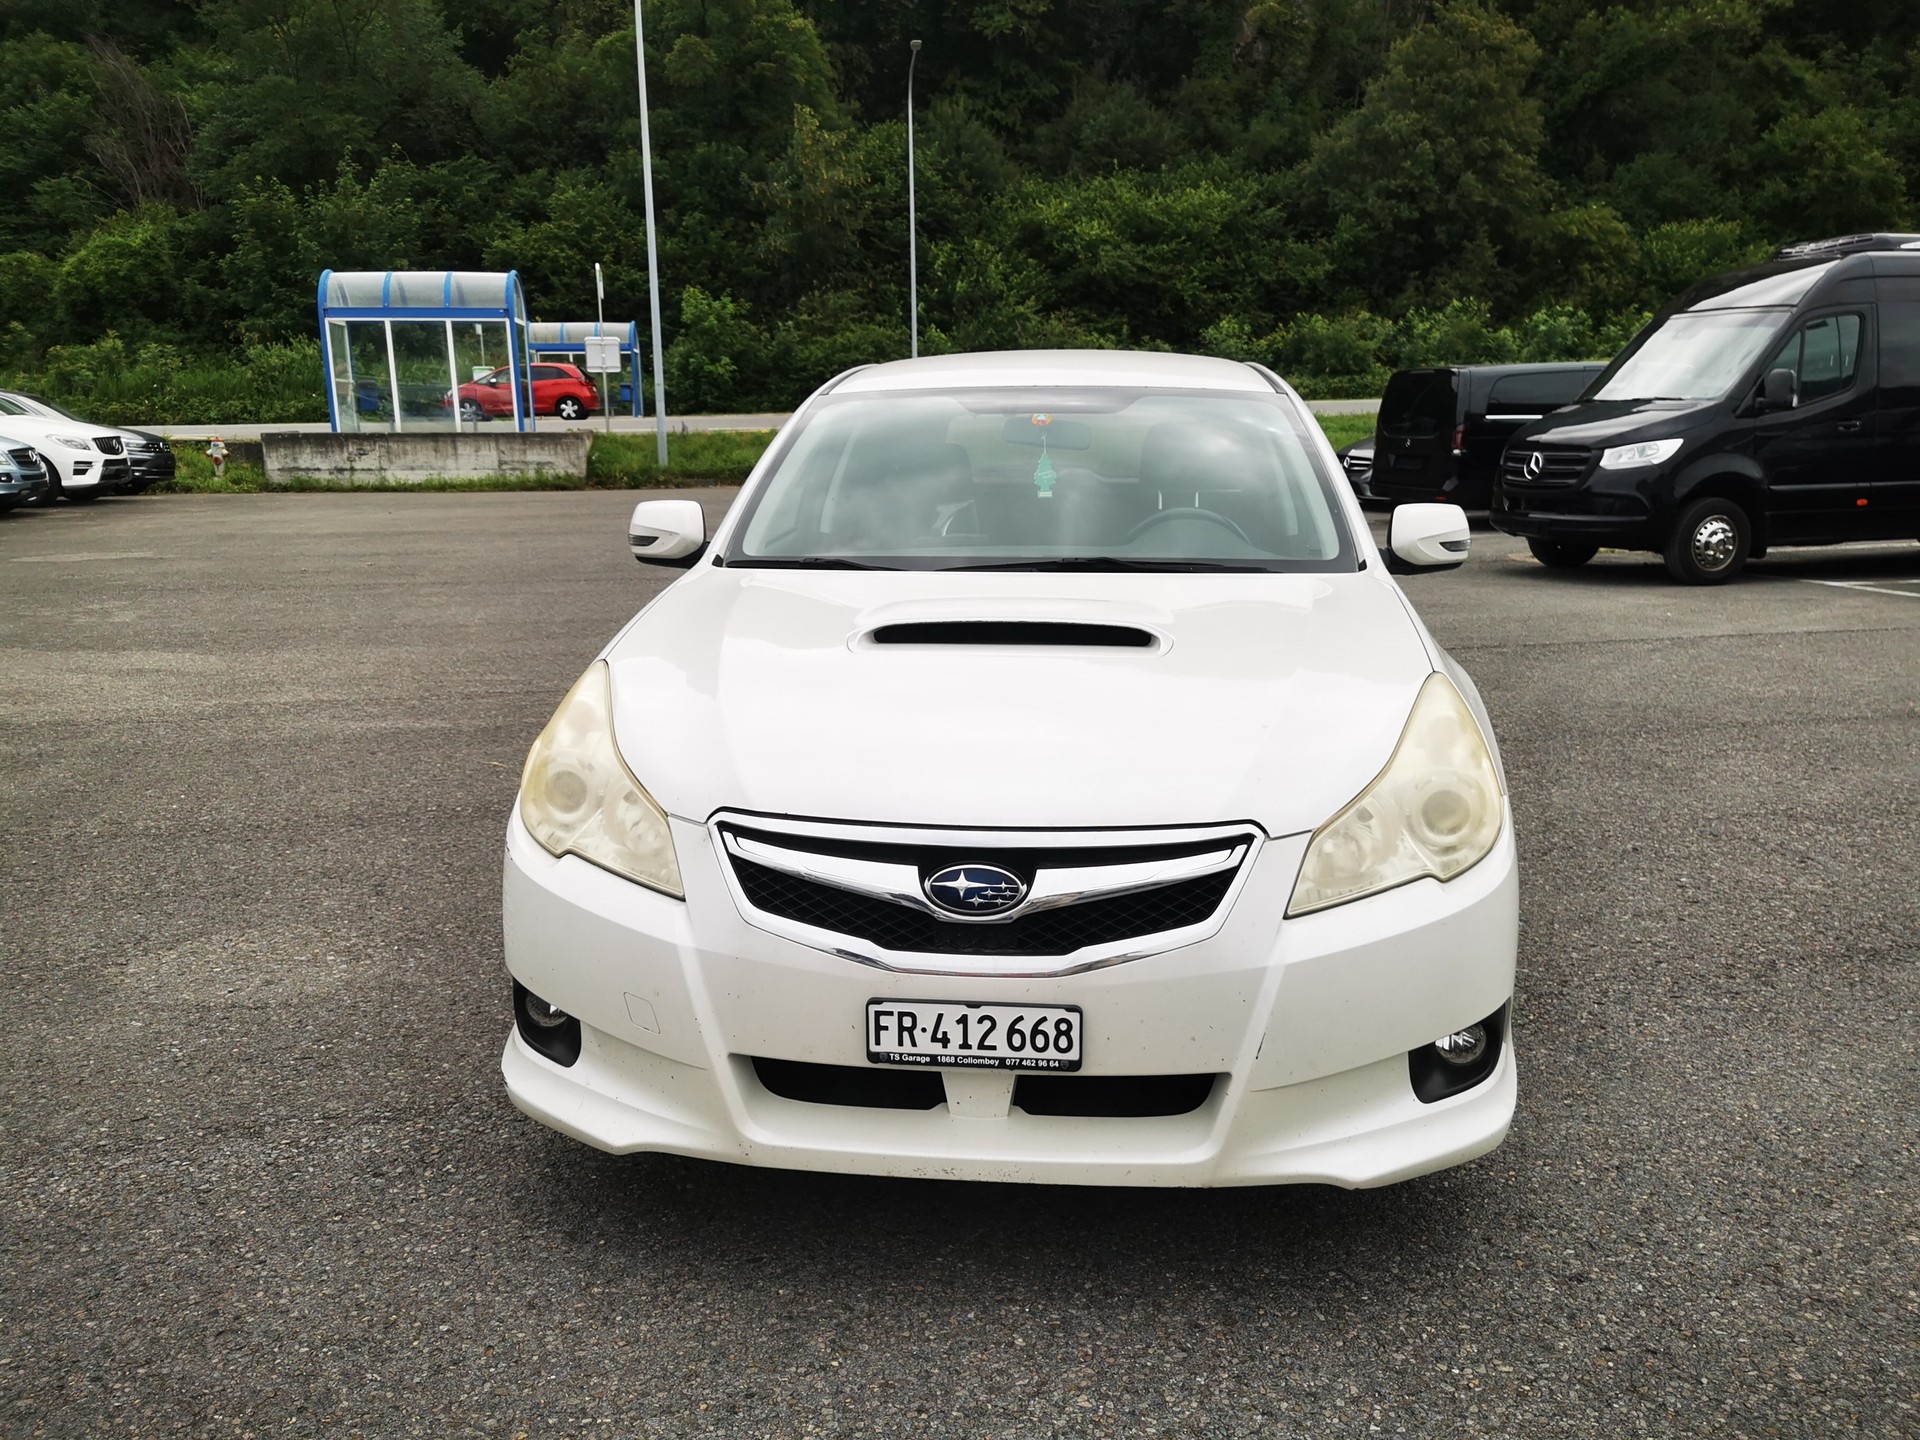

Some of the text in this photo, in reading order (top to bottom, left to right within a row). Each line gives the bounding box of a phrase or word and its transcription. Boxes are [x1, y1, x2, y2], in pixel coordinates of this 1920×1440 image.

[889, 1053, 900, 1061] TS
[902, 1054, 931, 1064] Garage
[937, 1055, 956, 1063] 1868
[957, 1056, 1000, 1067] Collombey
[1005, 1058, 1020, 1066] 077
[1021, 1059, 1036, 1067] 462
[1049, 1060, 1060, 1068] 64
